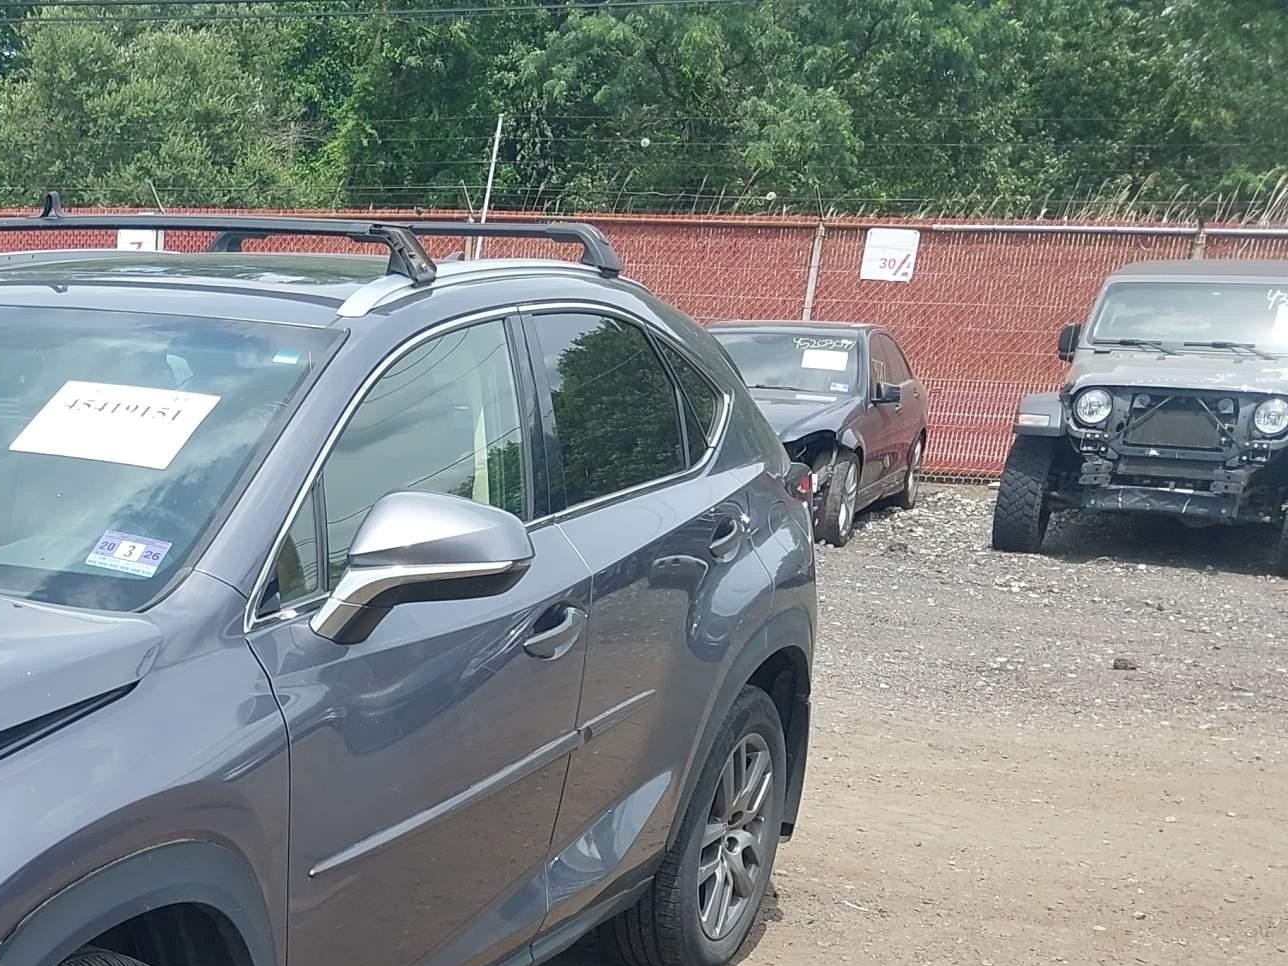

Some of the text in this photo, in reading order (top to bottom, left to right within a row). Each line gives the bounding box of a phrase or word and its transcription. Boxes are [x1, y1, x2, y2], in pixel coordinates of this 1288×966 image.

[100, 541, 161, 560] 20 3 26
